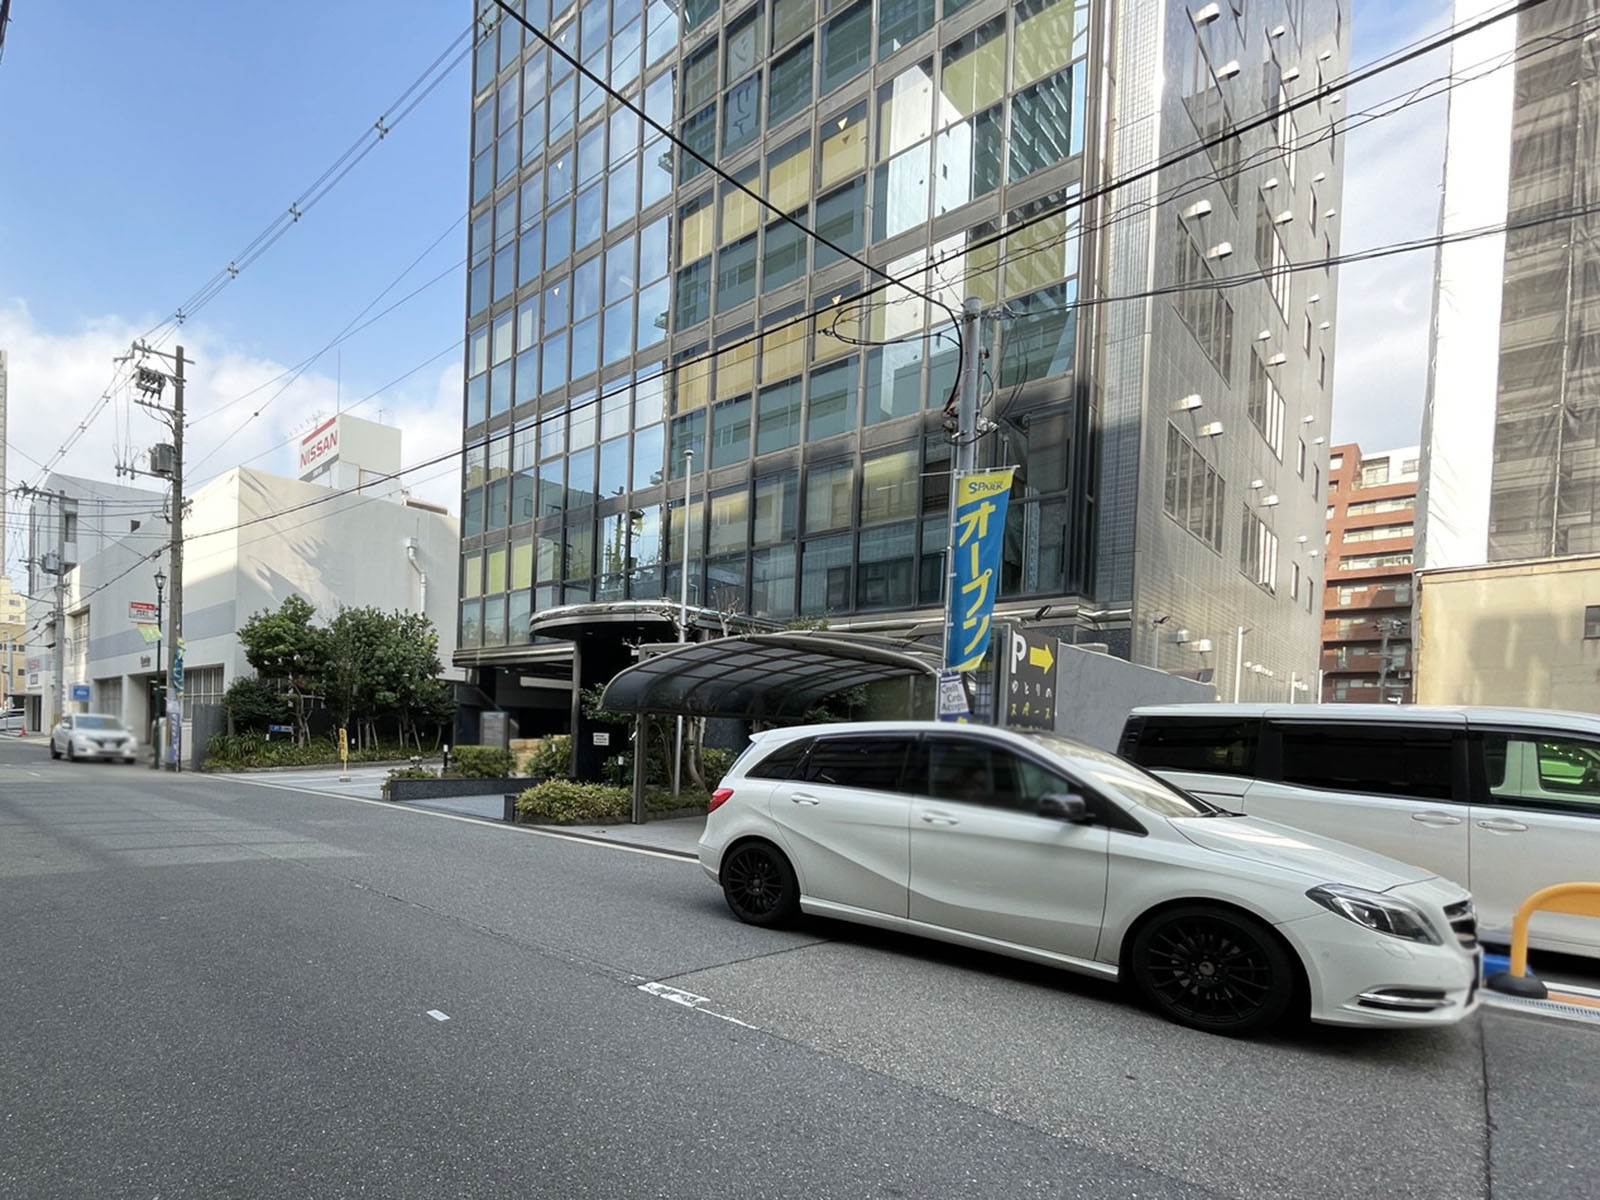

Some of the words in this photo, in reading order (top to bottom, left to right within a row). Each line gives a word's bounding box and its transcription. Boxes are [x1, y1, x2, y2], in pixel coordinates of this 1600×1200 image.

[300, 430, 338, 468] NISSAN
[958, 501, 997, 655] オープン
[1010, 630, 1027, 674] P
